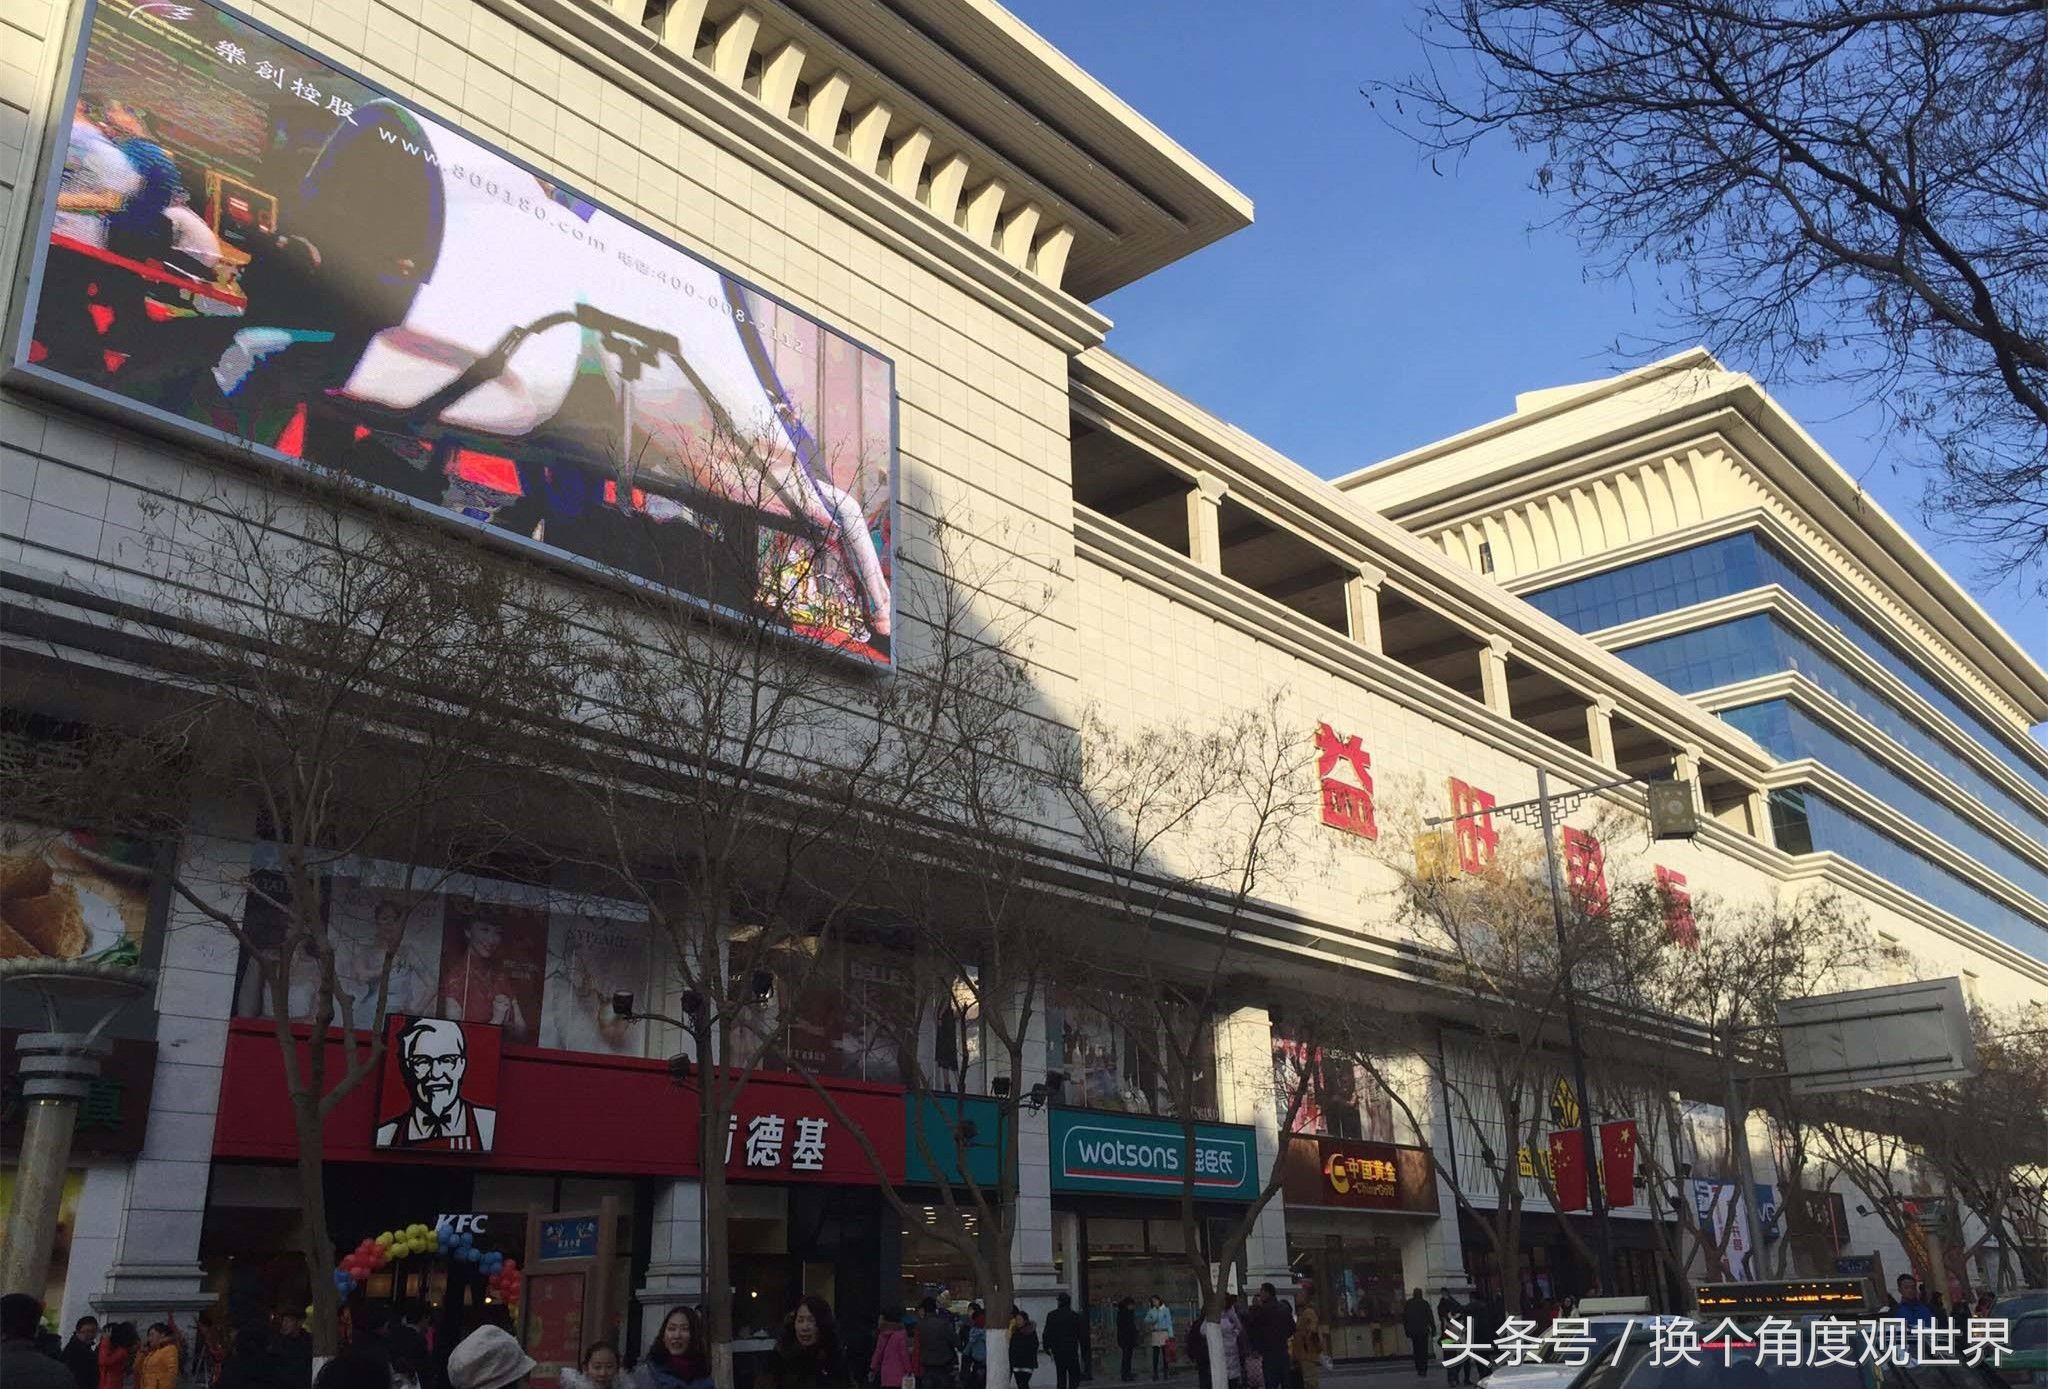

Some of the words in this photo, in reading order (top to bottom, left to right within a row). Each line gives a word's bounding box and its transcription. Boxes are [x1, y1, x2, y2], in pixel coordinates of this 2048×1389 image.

[214, 39, 359, 127] 樂創控股
[724, 1114, 829, 1170] 德基
[1078, 1138, 1179, 1171] watsons
[434, 1214, 488, 1234] KFC
